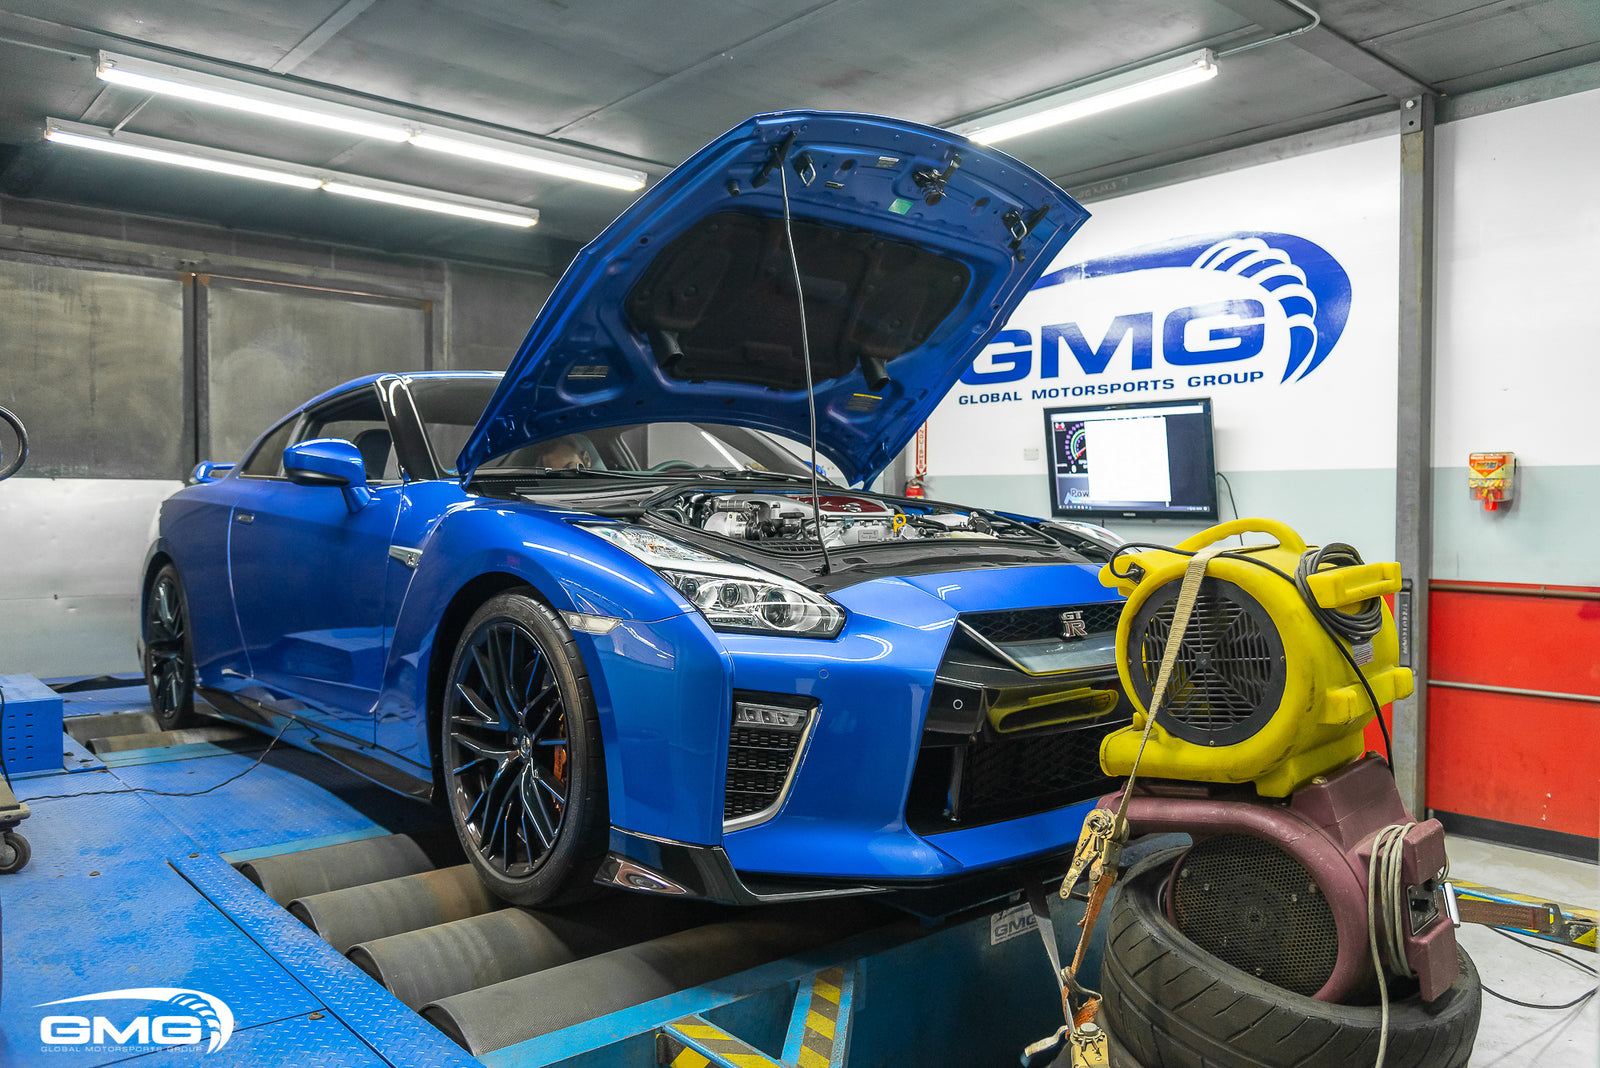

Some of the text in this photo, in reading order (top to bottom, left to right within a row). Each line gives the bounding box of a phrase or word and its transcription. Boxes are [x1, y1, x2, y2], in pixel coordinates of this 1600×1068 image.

[959, 298, 1265, 386] GMG
[958, 370, 1264, 405] GLOBAL MOTORSPORTS GROUP
